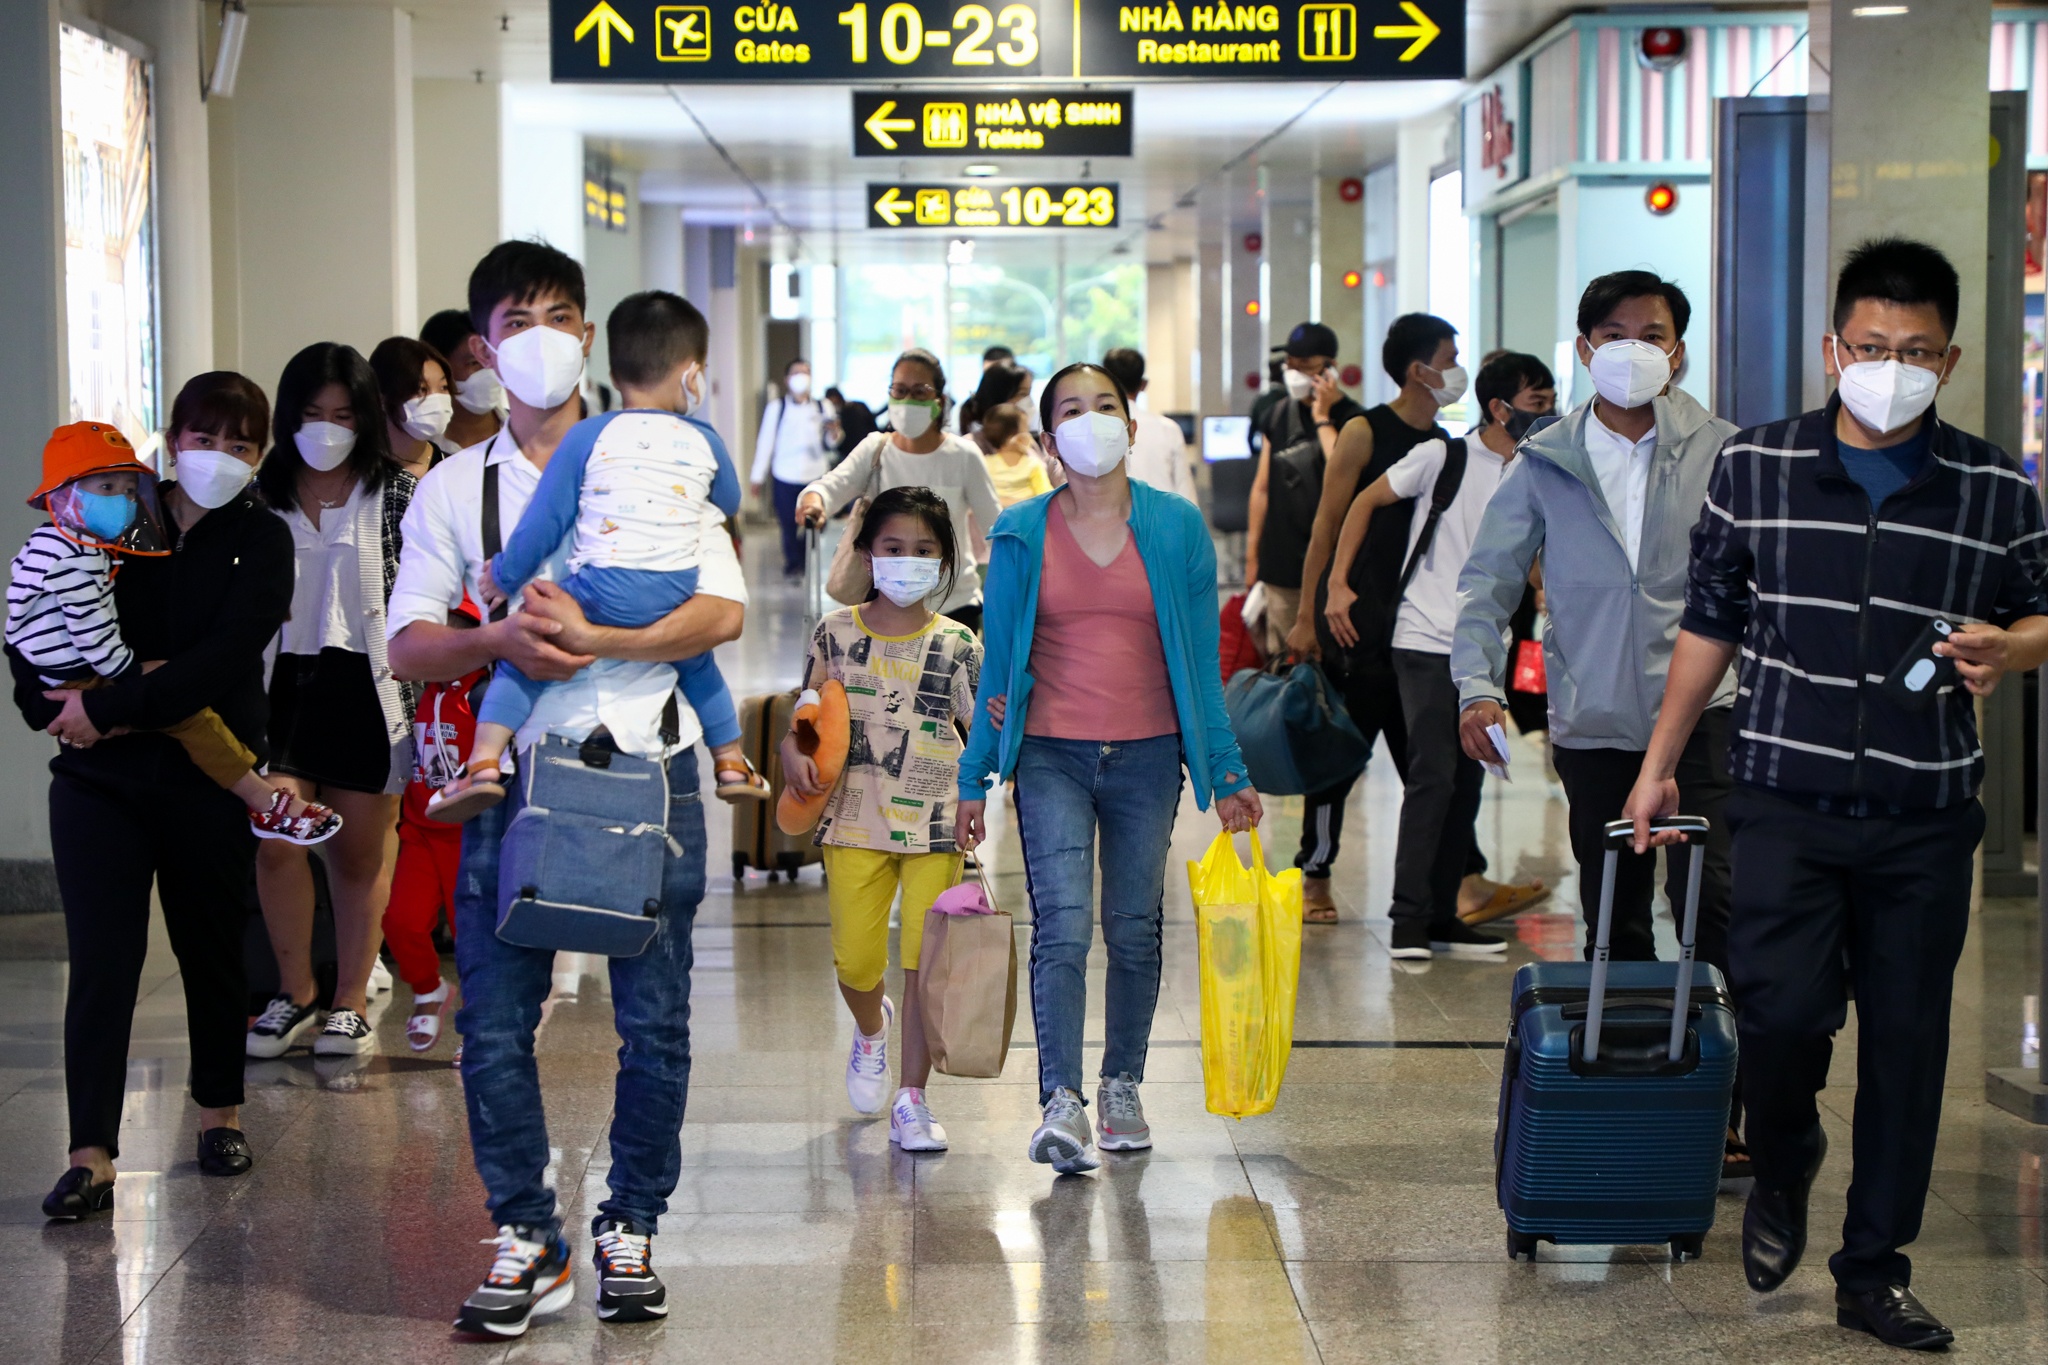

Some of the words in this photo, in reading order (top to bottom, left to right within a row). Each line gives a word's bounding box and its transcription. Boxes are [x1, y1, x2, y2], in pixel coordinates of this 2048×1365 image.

[734, 0, 799, 32] CỬA
[1119, 0, 1184, 32] NHÀ
[1191, 0, 1279, 32] HÀNG
[838, 2, 1038, 66] 10-23
[734, 38, 811, 63] Gates
[1138, 39, 1280, 63] Restaurant
[975, 98, 1026, 126] NHÀ
[1028, 98, 1061, 129] VỆ
[1065, 102, 1121, 126] SINH
[1001, 186, 1115, 226] 10-23
[868, 655, 920, 683] MANGO
